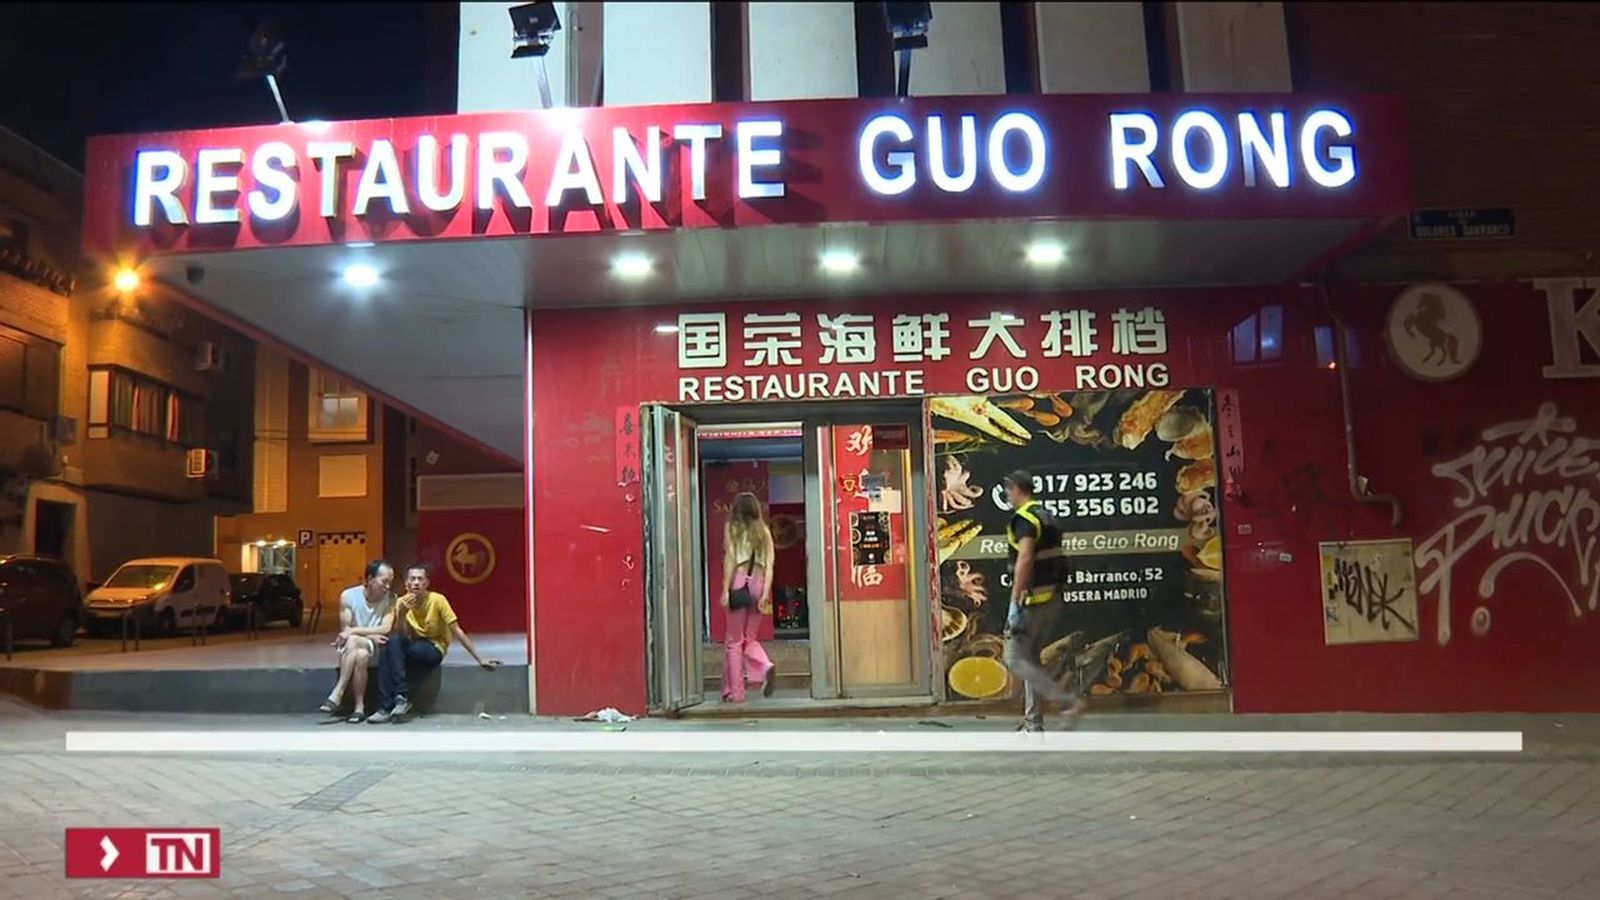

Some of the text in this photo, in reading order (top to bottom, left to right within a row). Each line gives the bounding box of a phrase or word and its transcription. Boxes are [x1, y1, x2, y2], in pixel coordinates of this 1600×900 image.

[133, 109, 1357, 227] RESTAURANTE GUO RONG
[678, 306, 1168, 369] 国荣海鲜大排档
[679, 362, 1168, 401] RESTAURANTE GUO RONG
[1032, 471, 1158, 494] 917 923 246
[1075, 498, 1115, 517] 356
[1120, 496, 1159, 515] 602
[300, 531, 310, 545] P
[1093, 534, 1129, 551] Guo
[1134, 531, 1180, 551] Rong
[1144, 567, 1163, 581] 52
[1063, 587, 1148, 603] USERA MADRID
